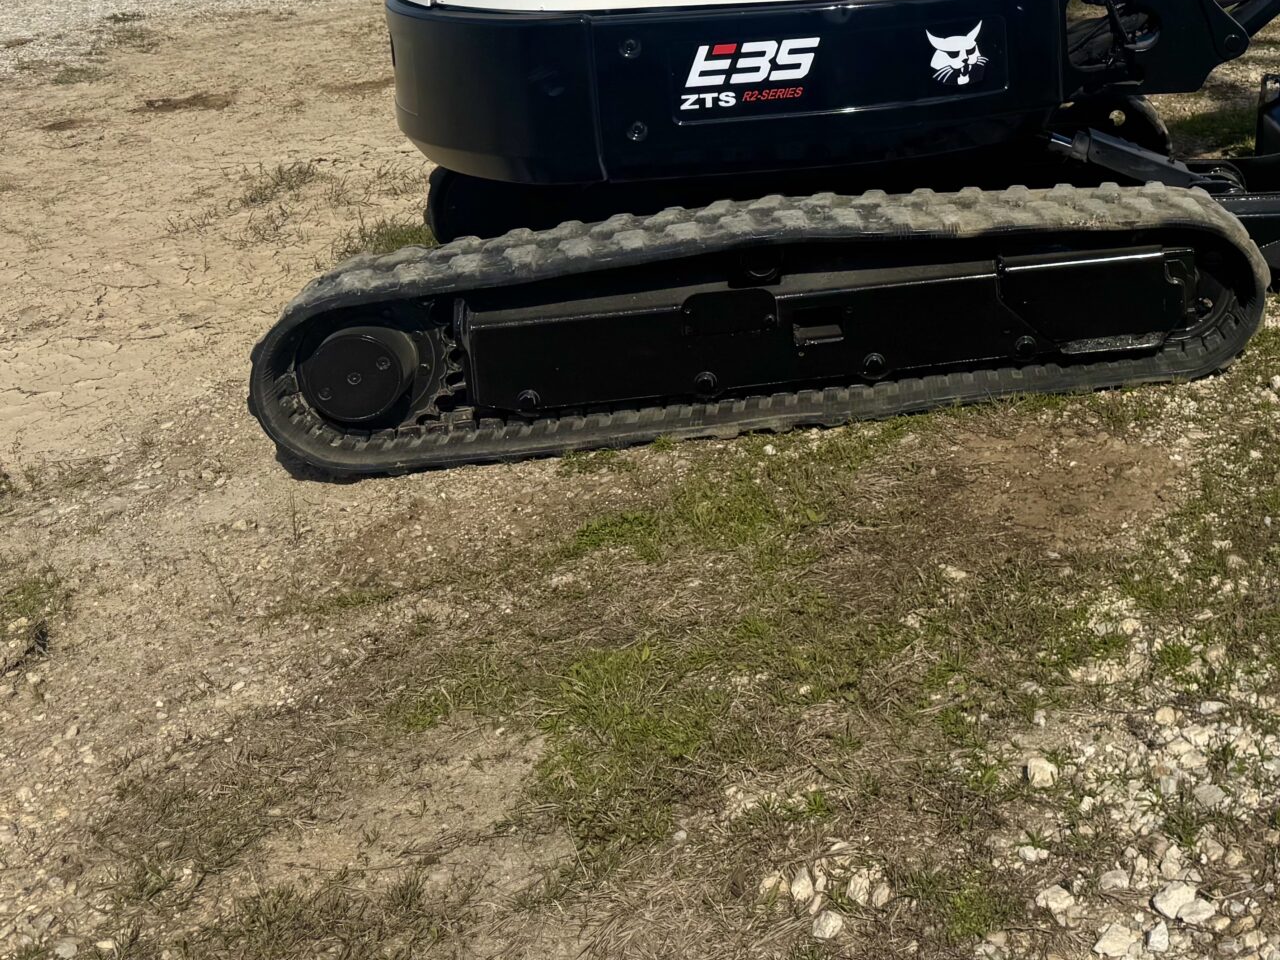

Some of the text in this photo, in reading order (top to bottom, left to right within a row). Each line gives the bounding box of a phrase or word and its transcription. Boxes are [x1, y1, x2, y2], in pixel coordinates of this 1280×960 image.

[685, 37, 820, 87] E35
[679, 87, 803, 110] ZTS R2-SERIES
